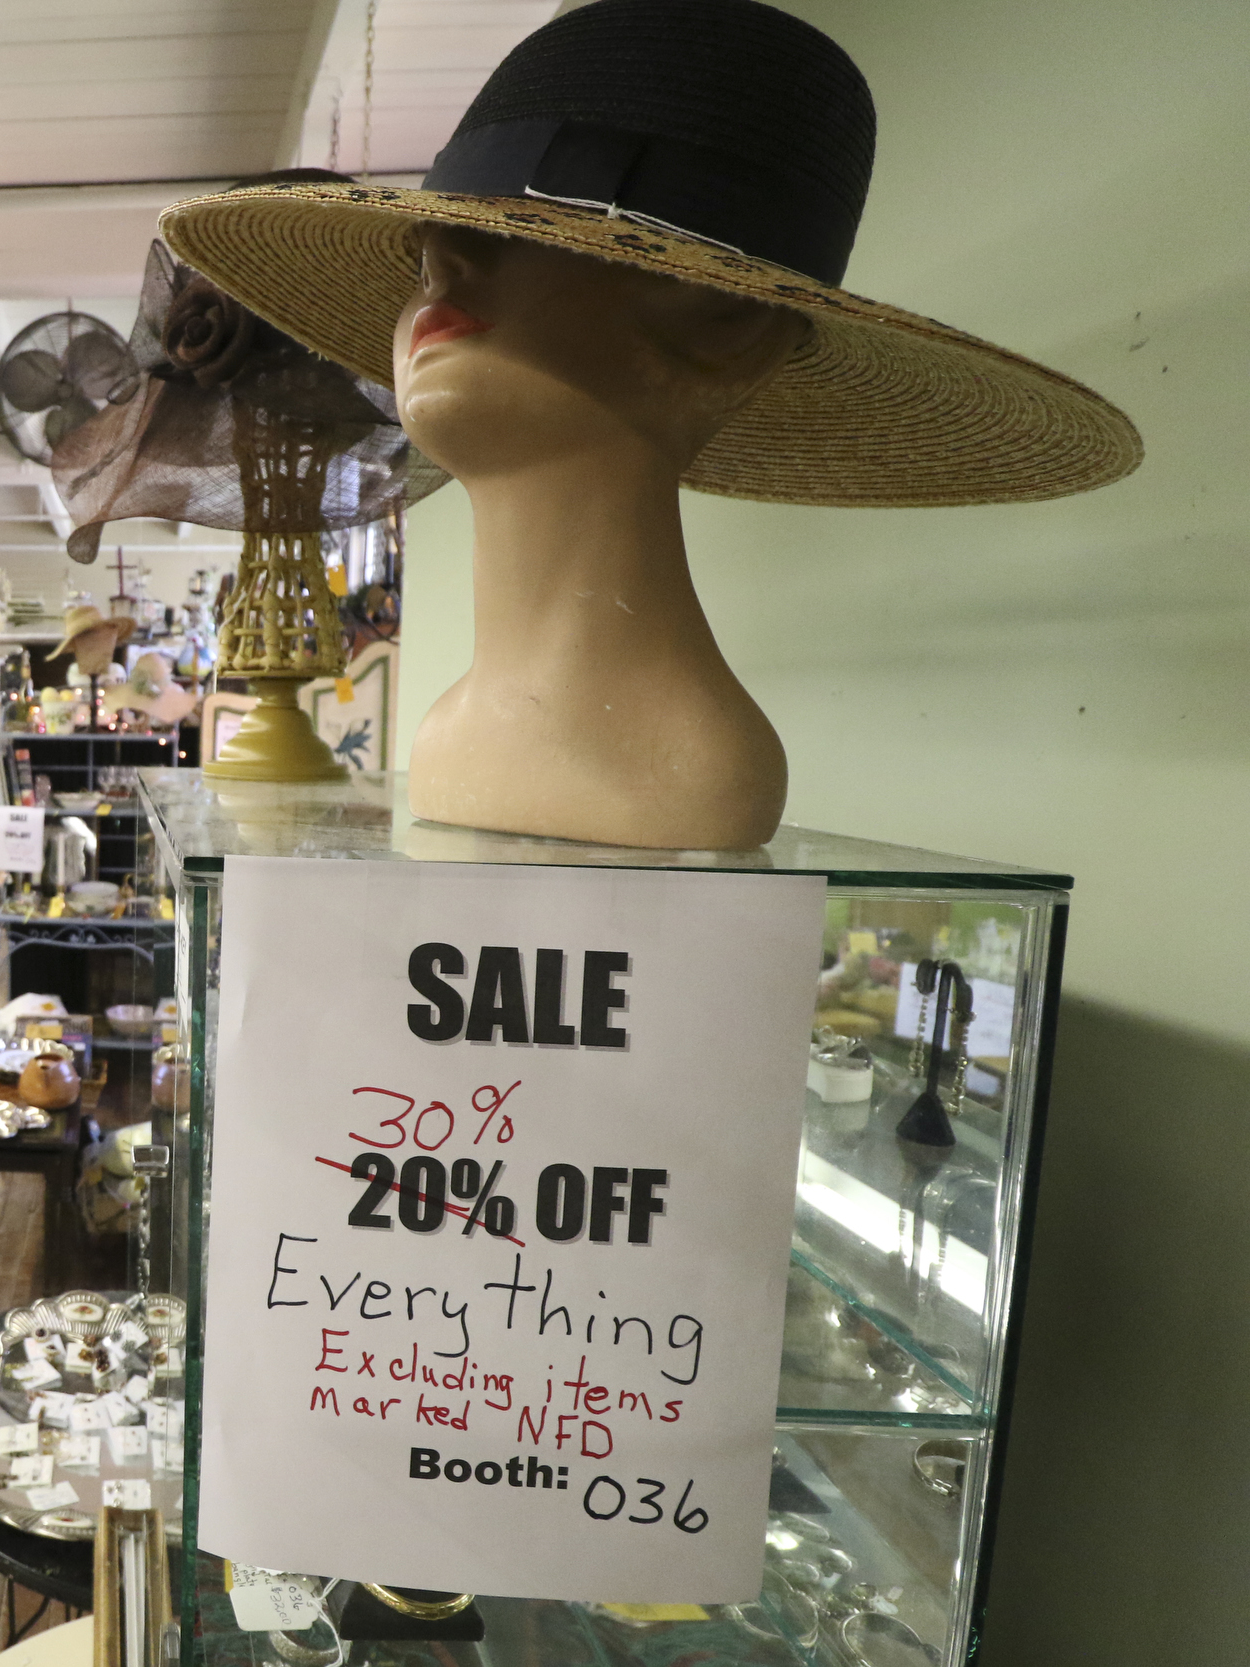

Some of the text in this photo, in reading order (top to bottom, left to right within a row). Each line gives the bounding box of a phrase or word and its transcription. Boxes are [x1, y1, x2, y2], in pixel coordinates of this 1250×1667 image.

[407, 943, 631, 1049] SALE
[349, 1081, 522, 1151] 30%
[347, 1152, 668, 1245] 20% OFF
[267, 1232, 704, 1386] Everything
[315, 1328, 684, 1424] Excluding items
[517, 1405, 613, 1459] NFD
[409, 1448, 709, 1534] Booth: 036
